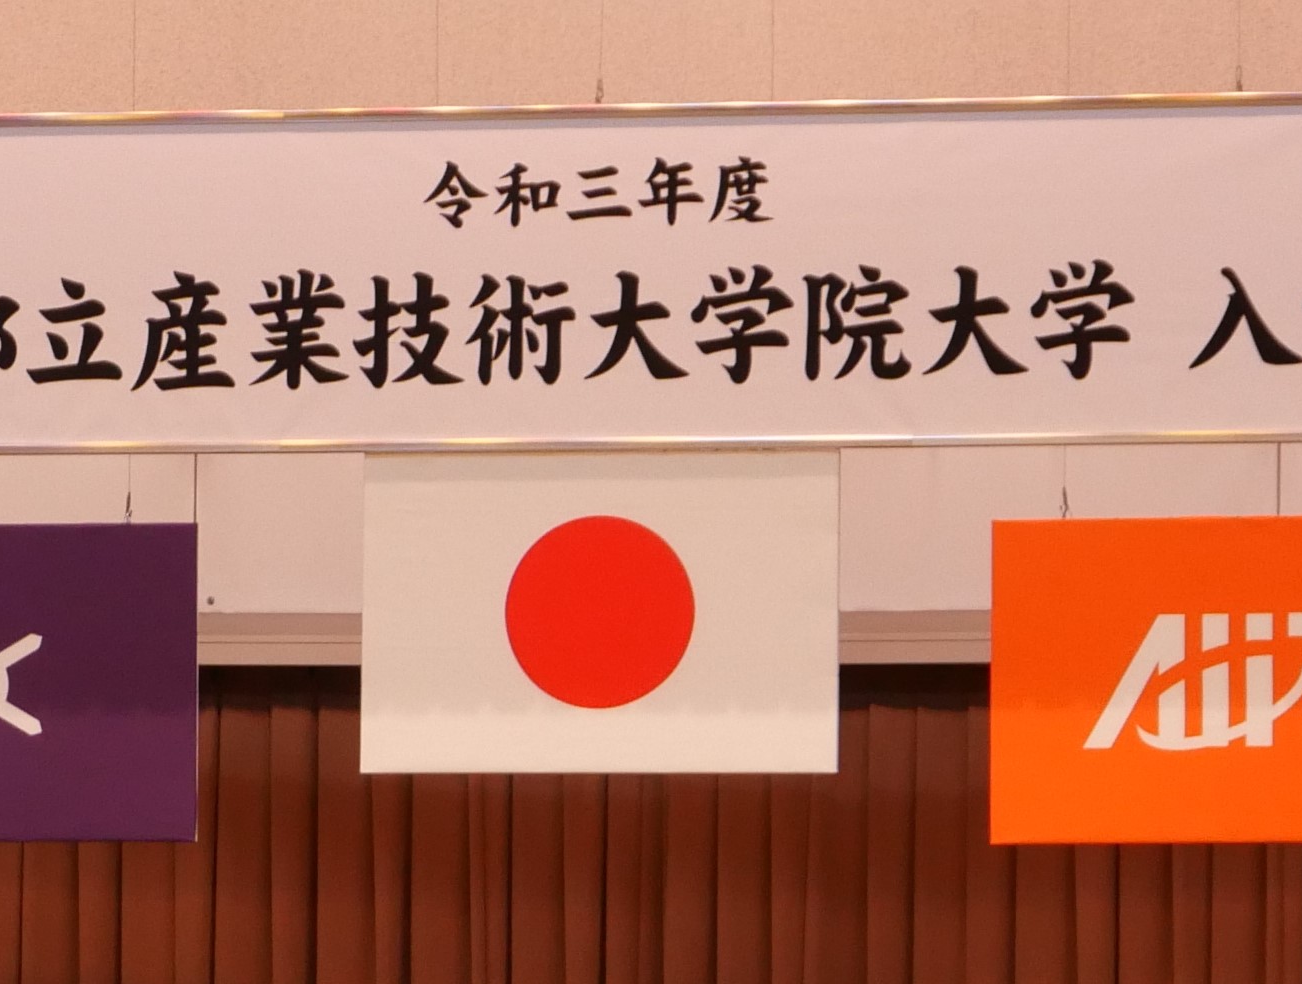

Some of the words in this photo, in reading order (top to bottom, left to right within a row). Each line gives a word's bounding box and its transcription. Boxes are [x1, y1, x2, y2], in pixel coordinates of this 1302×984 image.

[424, 155, 771, 229] 令和三年度
